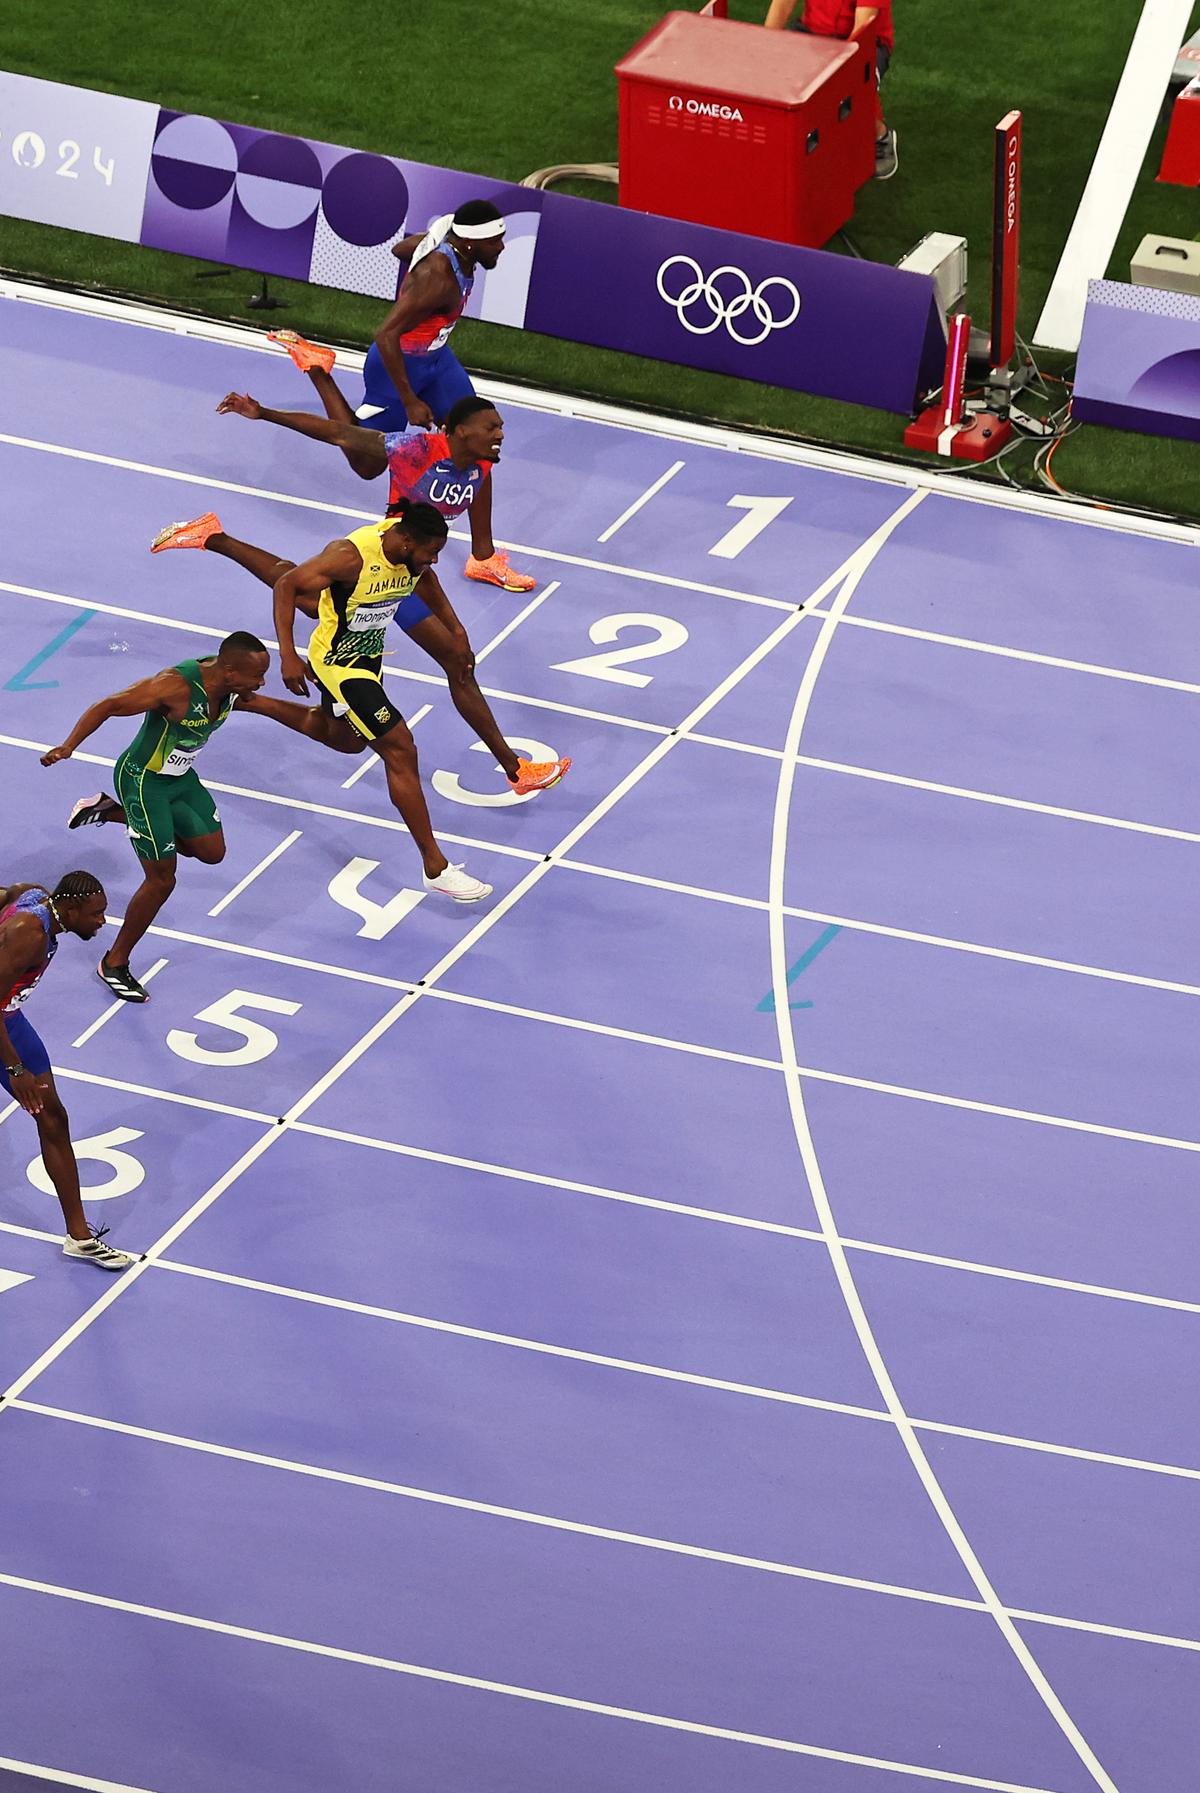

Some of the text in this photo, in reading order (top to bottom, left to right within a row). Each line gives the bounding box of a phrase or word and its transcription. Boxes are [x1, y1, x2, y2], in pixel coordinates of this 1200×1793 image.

[686, 99, 744, 122] OMEGA
[1007, 161, 1016, 233] OMEGA
[429, 479, 474, 505] USA
[707, 494, 795, 560] 1
[365, 575, 413, 595] JAMAICA
[548, 612, 689, 688] 2
[180, 717, 209, 727] SOUTH
[431, 736, 560, 807] 3
[327, 856, 428, 941] 4
[166, 988, 303, 1066] 5
[26, 1126, 146, 1201] 6
